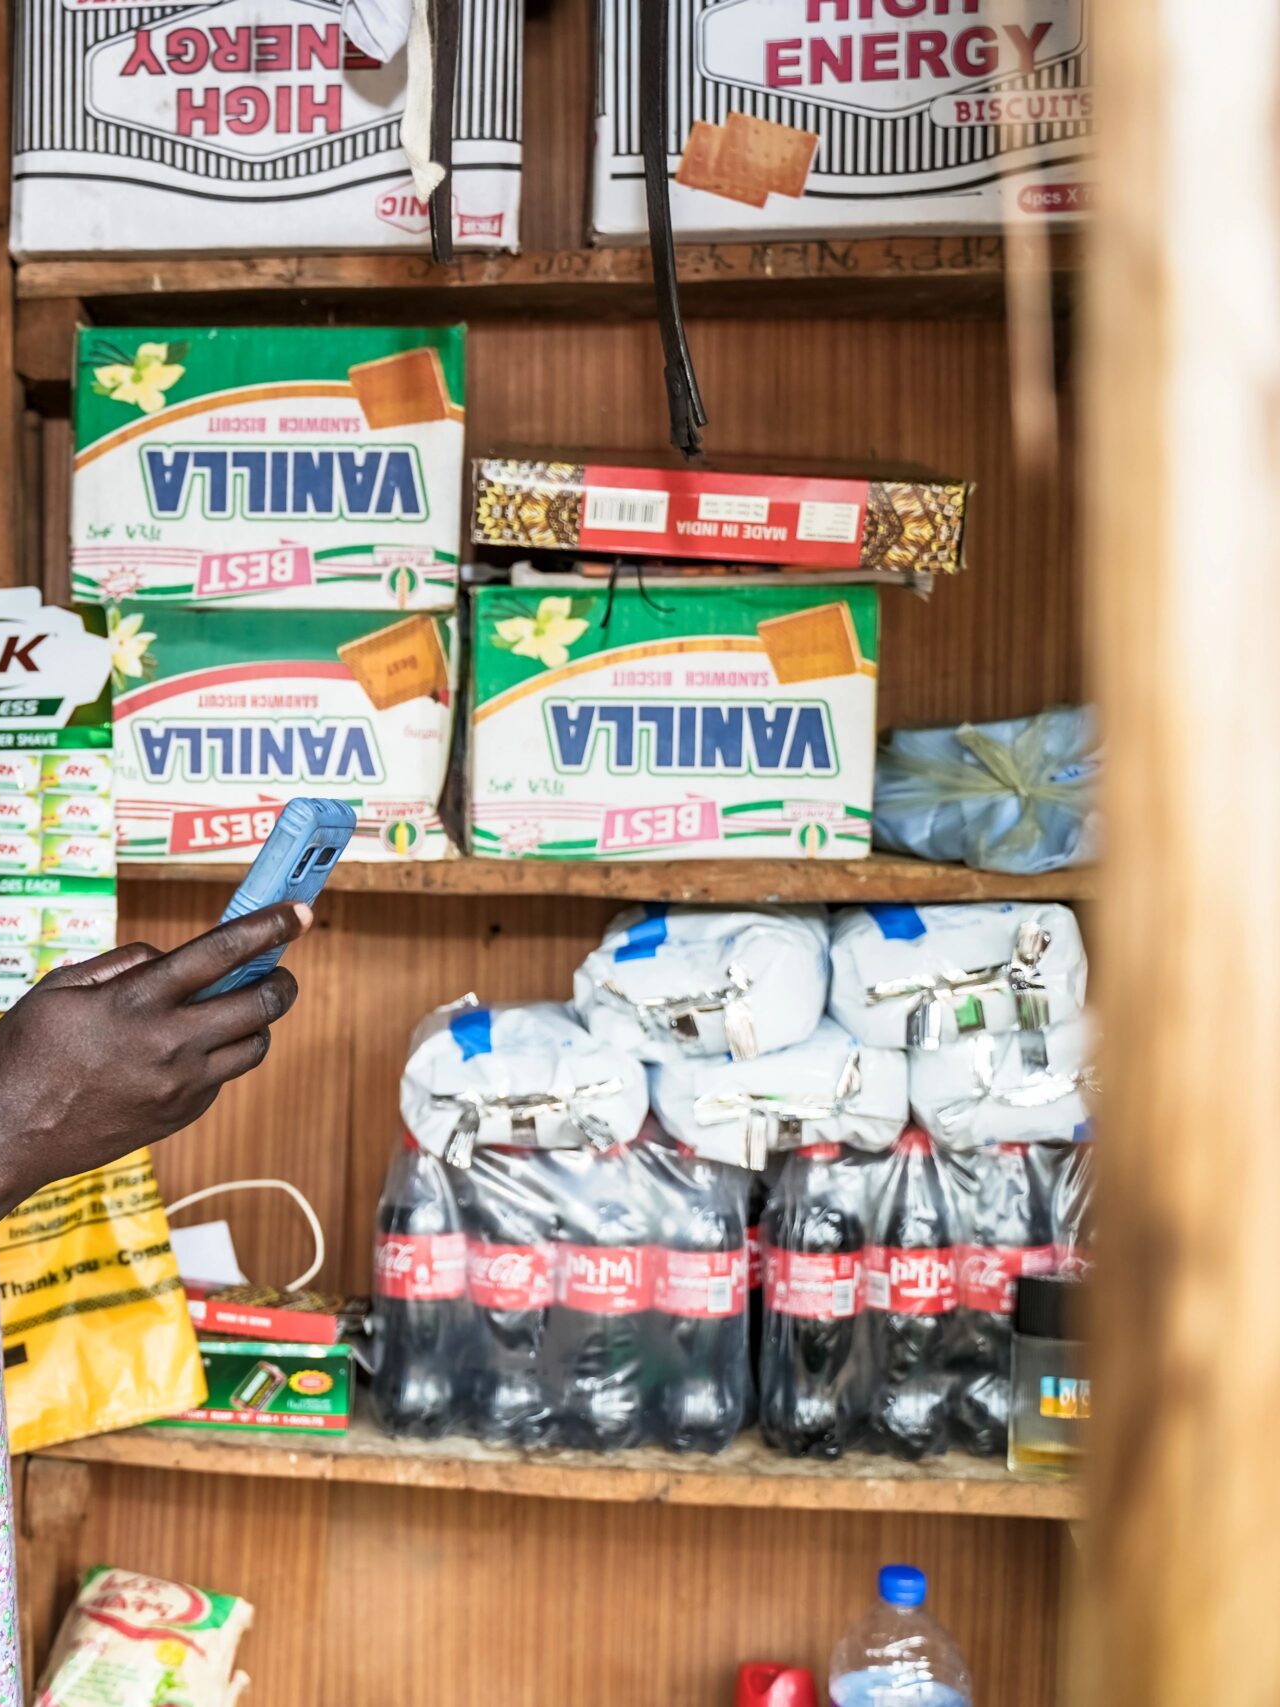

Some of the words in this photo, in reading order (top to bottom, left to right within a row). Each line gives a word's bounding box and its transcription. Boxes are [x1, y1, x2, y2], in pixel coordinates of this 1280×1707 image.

[764, 22, 1053, 88] ENERGY
[176, 84, 342, 136] HIGH
[955, 92, 1092, 122] BISCUITS
[380, 196, 429, 218] NIC
[208, 416, 266, 432] BISCUIT
[277, 417, 361, 433] SANDWICH
[145, 450, 421, 513] VANILLA
[676, 520, 715, 536] INDIA
[717, 523, 731, 537] IN
[741, 525, 788, 541] MADE
[202, 550, 295, 592] BEST
[612, 669, 672, 687] BISCUIT
[685, 671, 769, 688] SANDWICH
[198, 694, 248, 709] BISCUIT
[250, 694, 319, 709] SANDWICH
[16, 730, 59, 746] SHAVE
[550, 706, 832, 769] VANILLA
[139, 727, 377, 776] VANILLA
[65, 765, 92, 777] RK
[188, 811, 277, 847] BEST
[606, 804, 701, 848] BEST
[25, 879, 60, 893] EACH
[0, 1273, 59, 1300] Thank
[62, 1257, 101, 1284] you
[119, 1240, 172, 1267] Come
